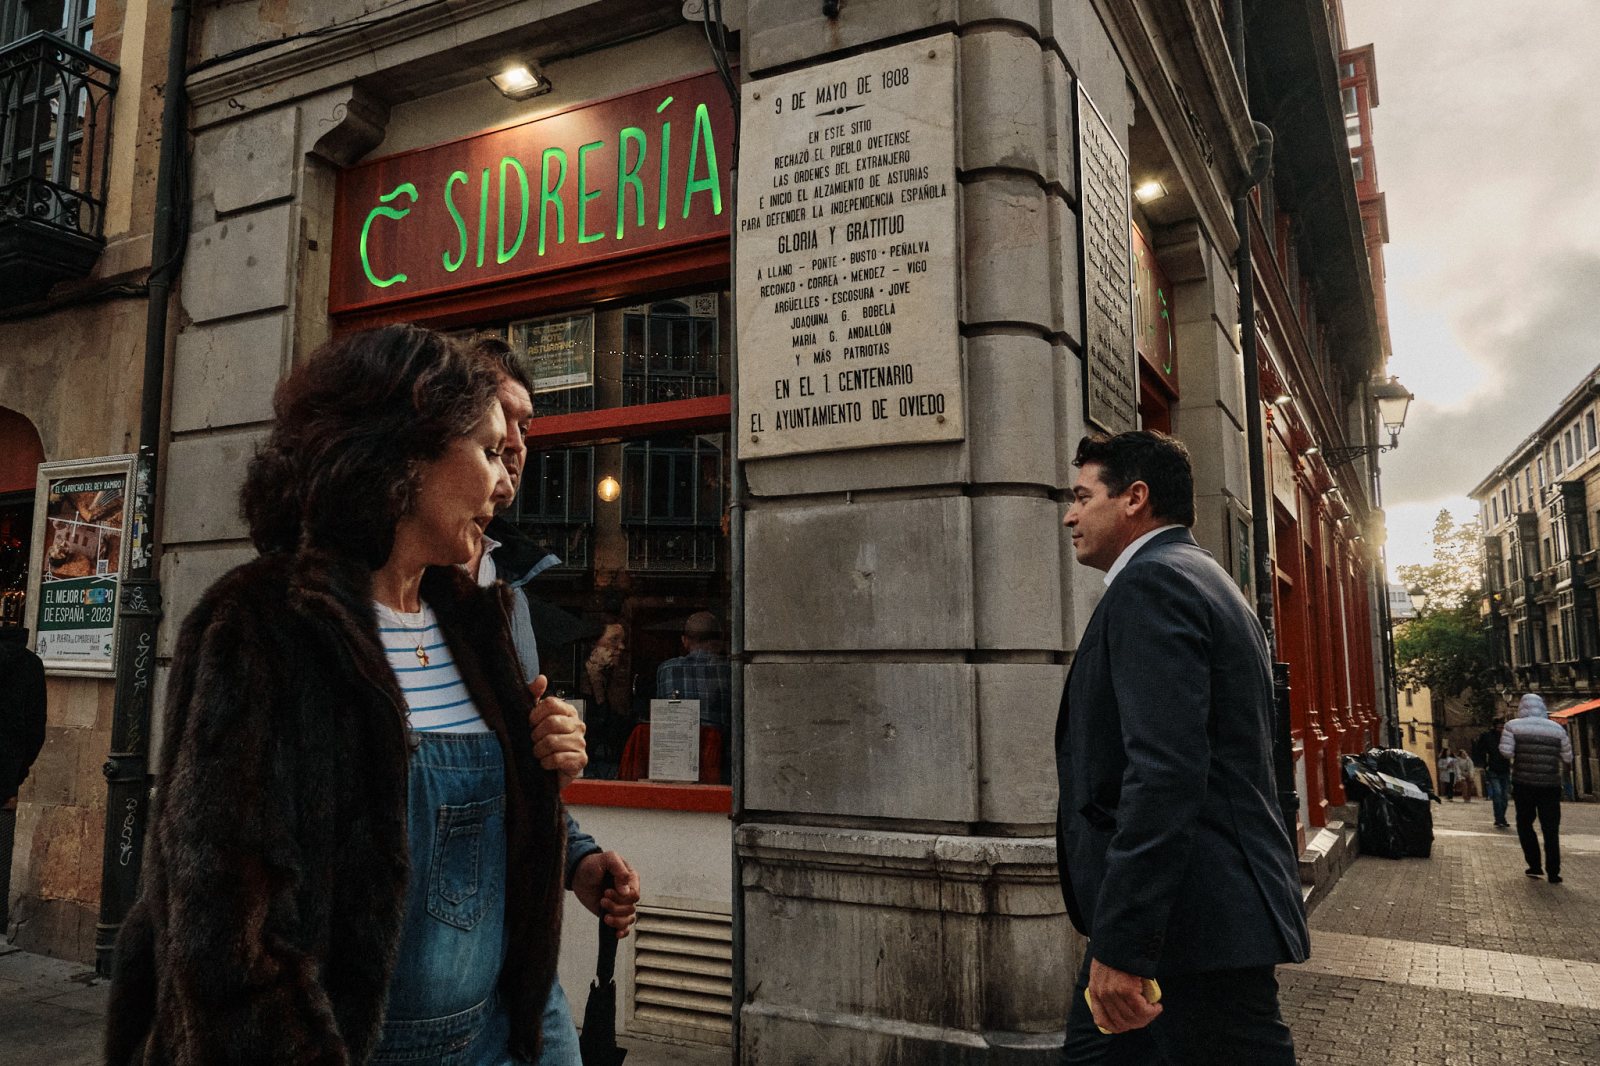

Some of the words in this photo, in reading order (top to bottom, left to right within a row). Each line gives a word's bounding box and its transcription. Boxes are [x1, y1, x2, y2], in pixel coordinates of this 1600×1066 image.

[776, 98, 782, 114] 9
[792, 92, 806, 110] DE
[816, 82, 847, 104] MAYO
[858, 75, 871, 94] DE
[882, 68, 909, 89] 1808
[809, 131, 819, 144] EN
[825, 126, 844, 140] ESTE
[851, 120, 871, 134] SITIO
[815, 149, 824, 161] EL
[831, 140, 861, 158] PUEBLO
[868, 131, 910, 149] OVETENSE
[442, 96, 722, 272] SIDRERÍA
[774, 176, 788, 188] LAS
[836, 162, 849, 176] DEL
[857, 150, 910, 171] EXTRANJERO
[798, 189, 807, 202] EL
[814, 179, 864, 198] ALZAMIENTO
[870, 174, 880, 188] DE
[888, 167, 928, 184] ASTURIAS
[742, 218, 760, 232] PARA
[767, 208, 805, 227] DEFENDER
[813, 206, 823, 218] LA
[831, 192, 894, 214] INDEPENDENCIA
[901, 184, 946, 203] ESPAÑOLA
[778, 229, 817, 254] GLORIA
[829, 226, 835, 245] Y
[847, 215, 904, 242] GRATITUD
[758, 269, 762, 280] A
[768, 264, 792, 278] LLANO
[812, 256, 837, 271] PONTE
[851, 250, 877, 265] BUSTO
[890, 241, 929, 257] PEÑALVA
[761, 284, 795, 298] RECONCO
[808, 277, 838, 289] CORREA
[907, 260, 927, 273] VIGO
[775, 296, 819, 314] ARGÜELLES
[832, 287, 874, 304] ESCOSURA
[889, 282, 910, 296] JOVE
[791, 314, 828, 329] JOAQUINA
[842, 310, 849, 322] G.
[863, 303, 895, 318] BOBELA
[793, 334, 816, 348] MARÍA
[830, 331, 837, 342] G.
[848, 322, 891, 340] ANDALLÓN
[796, 355, 800, 366] Y
[814, 349, 831, 364] MÁS
[844, 343, 889, 359] PATRIOTAS
[776, 380, 789, 400] EN
[800, 377, 814, 396] EL
[839, 364, 912, 391] CENTENARIO
[751, 414, 764, 432] EL
[776, 402, 861, 430] AYUNTAMIENTO
[873, 399, 888, 420] DE
[900, 394, 944, 417] OVIEDO
[61, 484, 84, 493] CAPRICHO
[84, 482, 93, 491] DEL
[94, 482, 103, 490] REY
[104, 480, 122, 490] RAMIRO
[44, 608, 54, 622] DE
[56, 605, 84, 622] ESPAÑA
[91, 608, 112, 622] 2023
[46, 590, 55, 604] EL
[56, 590, 79, 604] MEJOR
